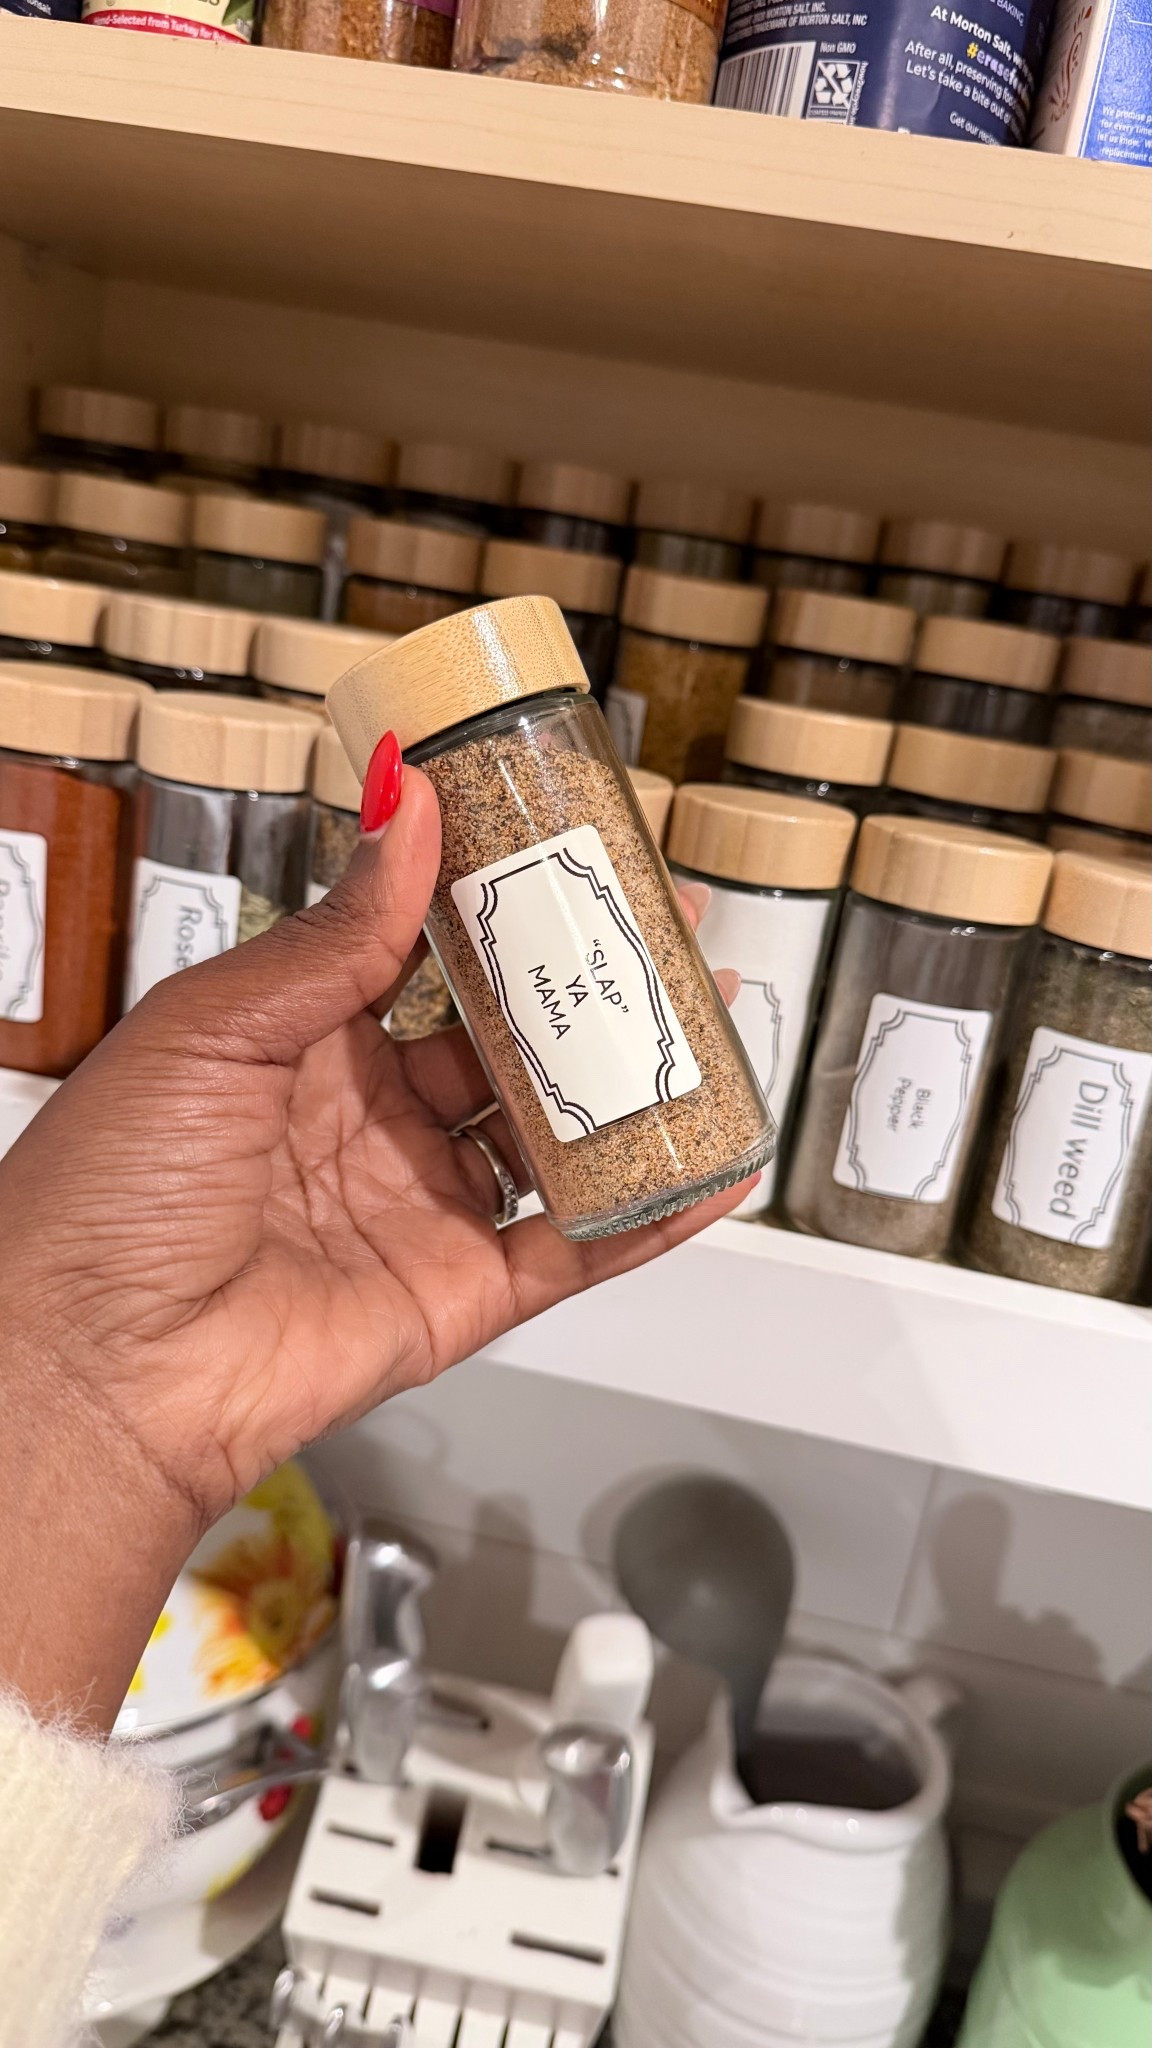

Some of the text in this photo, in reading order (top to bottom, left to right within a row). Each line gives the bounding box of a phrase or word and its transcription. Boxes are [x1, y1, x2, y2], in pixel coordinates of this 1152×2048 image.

[766, 5, 792, 19] MORTON
[811, 2, 826, 12] INC.
[788, 15, 798, 27] OF
[799, 14, 830, 26] MORTON
[831, 13, 851, 27] SALT,
[852, 14, 868, 26] INC
[147, 16, 170, 29] from
[171, 19, 199, 37] Turkey
[200, 27, 212, 38] for
[930, 5, 1012, 61] At Morton Salt,
[820, 41, 857, 54] Non GMO
[904, 40, 937, 61] After
[938, 52, 954, 71] all,
[954, 60, 1003, 100] preserving
[906, 59, 936, 81] Let's
[938, 68, 963, 93] take
[963, 84, 971, 97] a
[971, 86, 990, 109] bite
[990, 101, 1005, 120] out
[950, 110, 965, 129] Get
[965, 121, 979, 136] our
[1100, 118, 1113, 129] for
[1113, 122, 1134, 136] every
[1102, 104, 1115, 117] We
[1115, 110, 1146, 122] promise
[1101, 147, 1147, 162] replacement
[527, 964, 572, 1041] MAMA
[565, 974, 589, 1008] YA
[886, 1076, 913, 1132] Pepper
[907, 1088, 932, 1129] Black
[1047, 1080, 1109, 1220] Dill weed
